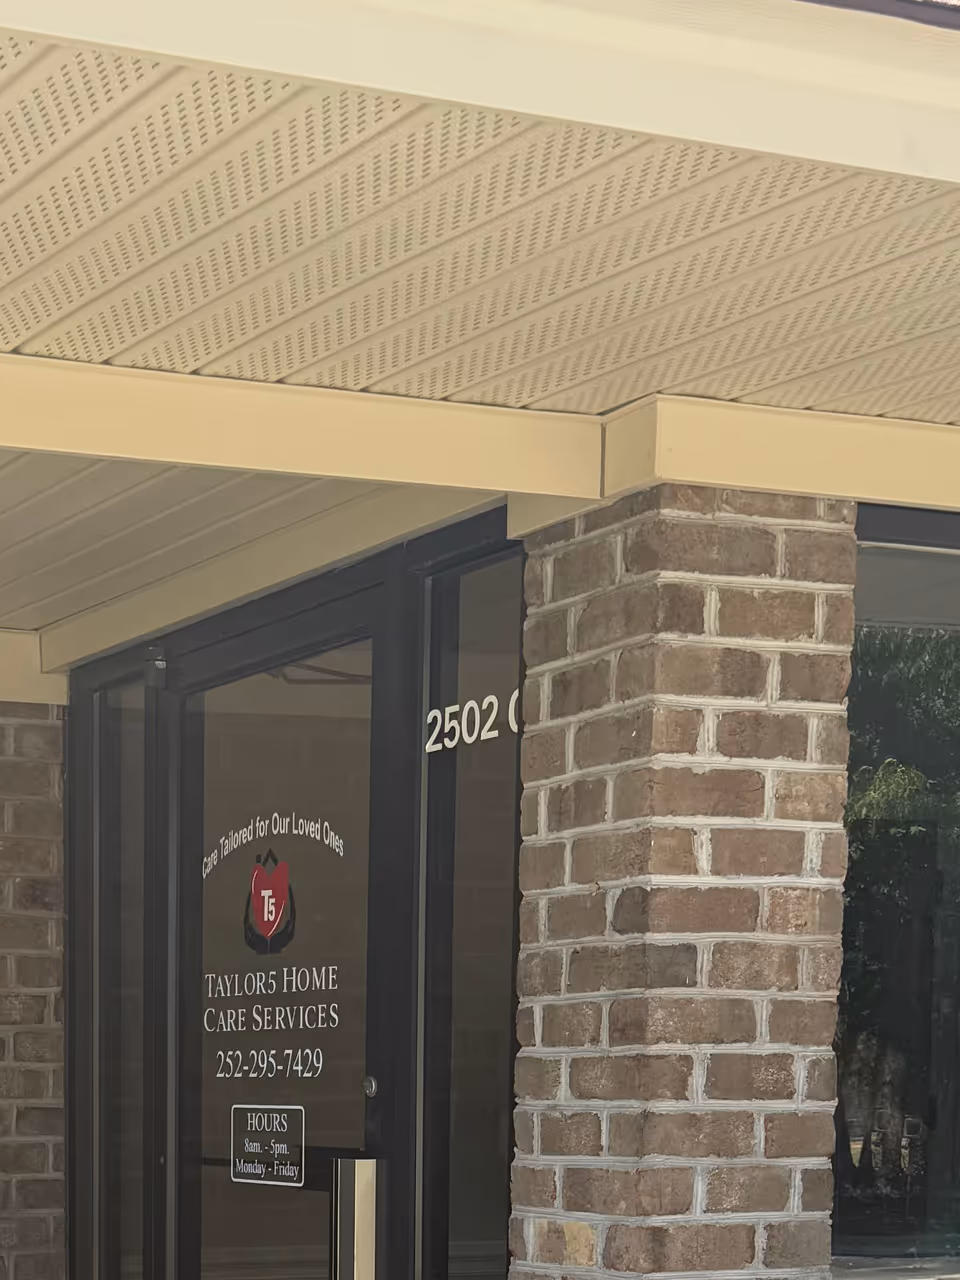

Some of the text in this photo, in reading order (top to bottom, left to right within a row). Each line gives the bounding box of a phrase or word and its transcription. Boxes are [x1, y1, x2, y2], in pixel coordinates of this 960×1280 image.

[425, 694, 500, 754] 2502
[202, 811, 345, 880] Care Tailored for Our Loved Ones
[260, 889, 276, 922] T5
[205, 965, 339, 997] TAYLOR5 HOME
[203, 1002, 340, 1033] CARE SERVICES
[215, 1048, 323, 1078] 252-295-7429
[246, 1112, 289, 1133] HOURS
[235, 1157, 267, 1178] Monday
[273, 1158, 300, 1181] Friday
